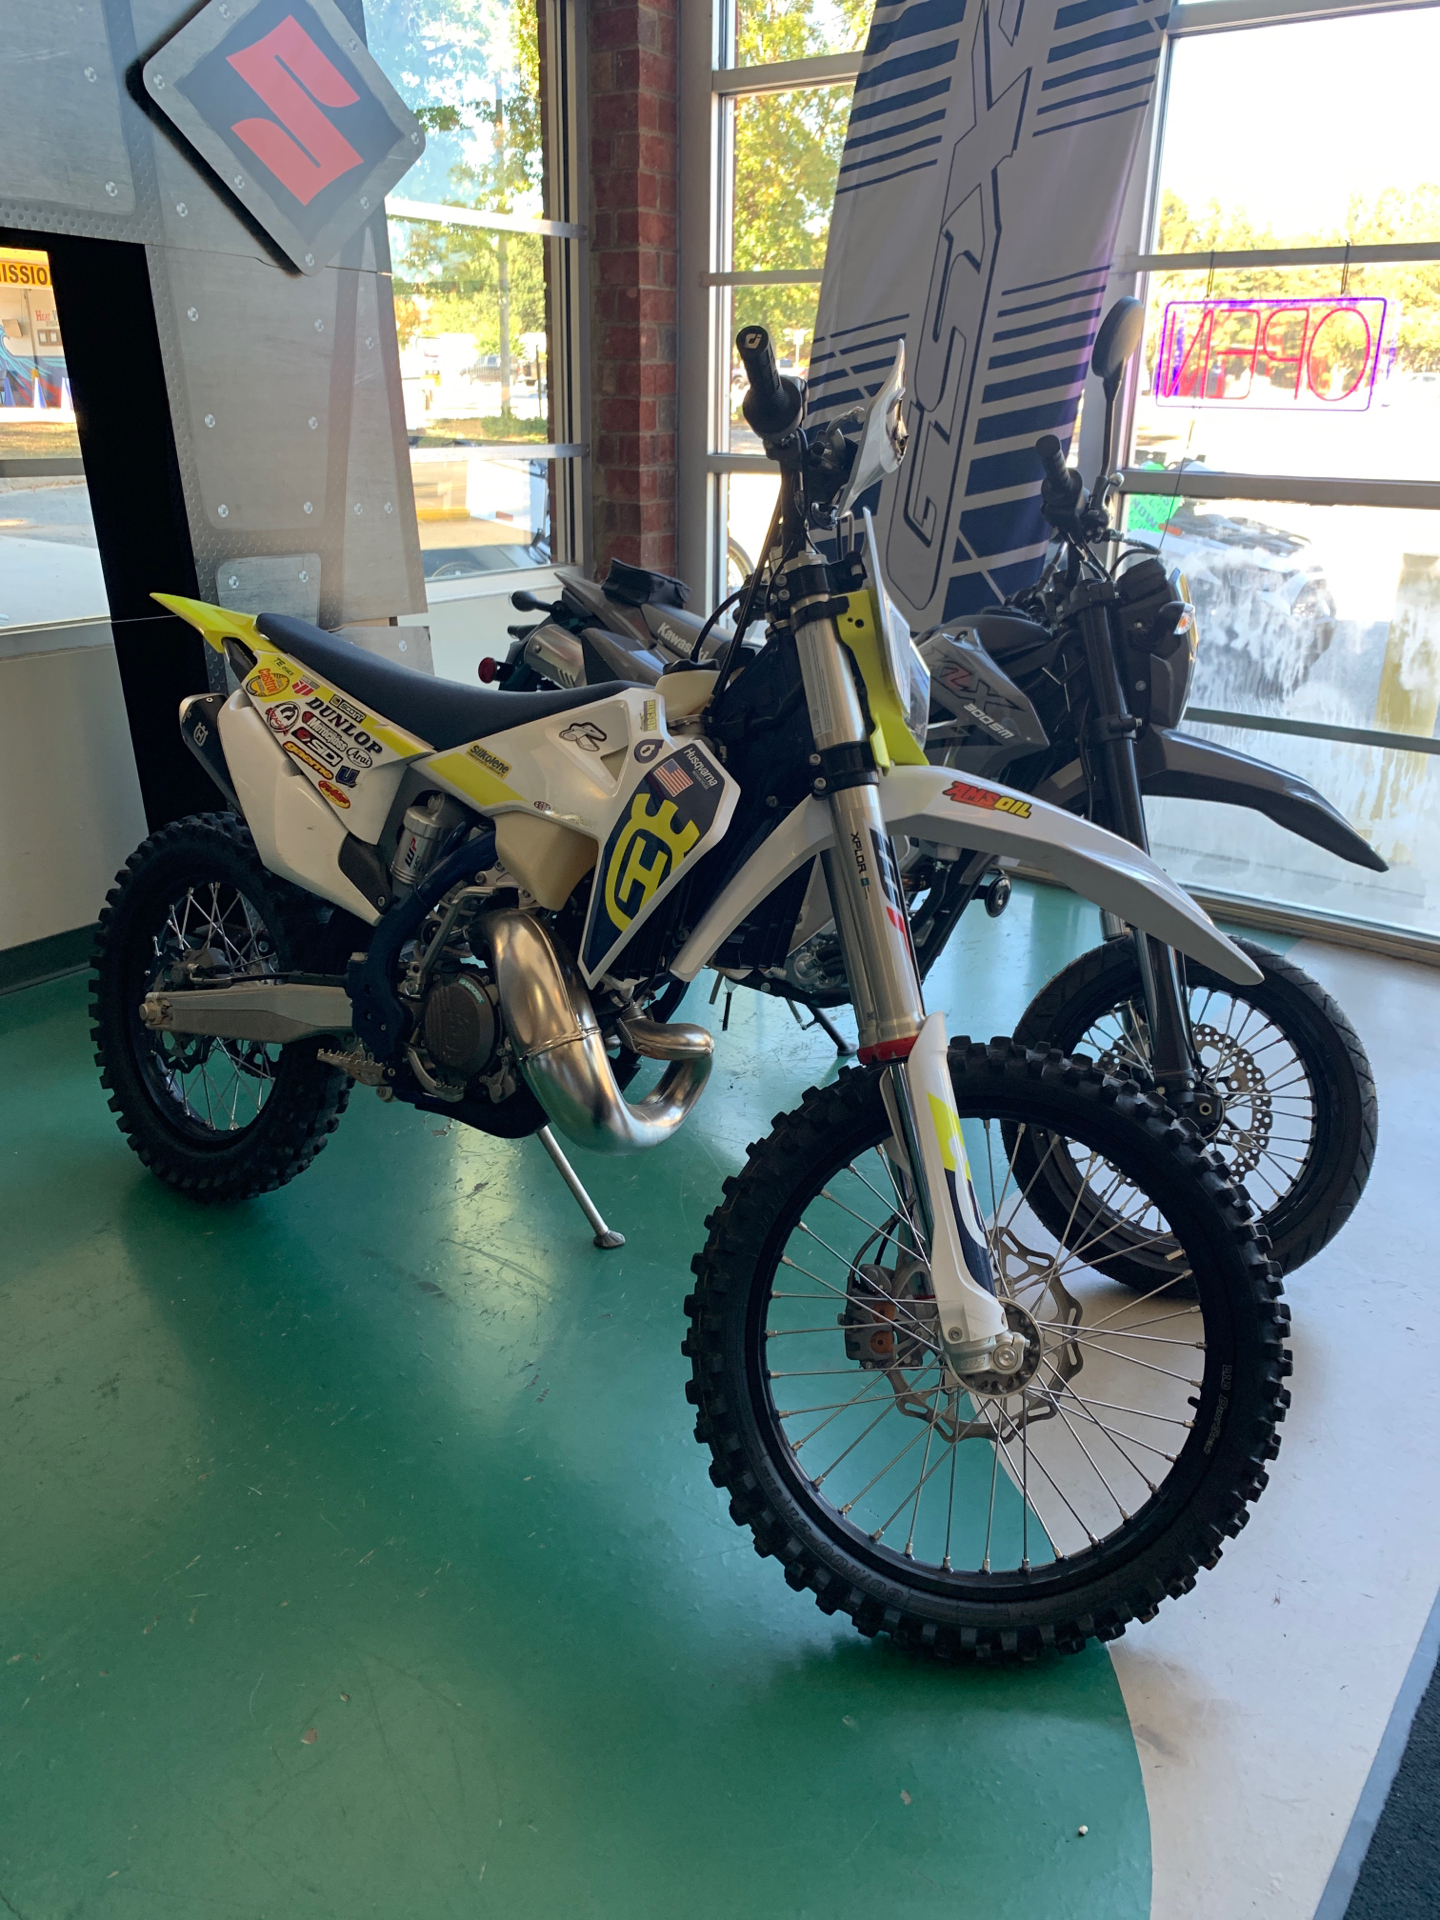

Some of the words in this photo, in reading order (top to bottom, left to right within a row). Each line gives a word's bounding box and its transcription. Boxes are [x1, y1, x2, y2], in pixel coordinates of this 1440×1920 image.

[0, 263, 52, 286] ISSIO
[657, 622, 710, 660] Kawaski
[258, 668, 279, 693] Castrol
[305, 696, 383, 754] DUNLOP
[340, 703, 364, 722] SCOTT
[646, 699, 657, 731] HINSON
[351, 750, 370, 765] Arai
[469, 744, 509, 774] Silkolene
[684, 747, 718, 787] Husqvarna
[942, 780, 1033, 819] AMSOIL
[850, 832, 867, 874] XPLOR
